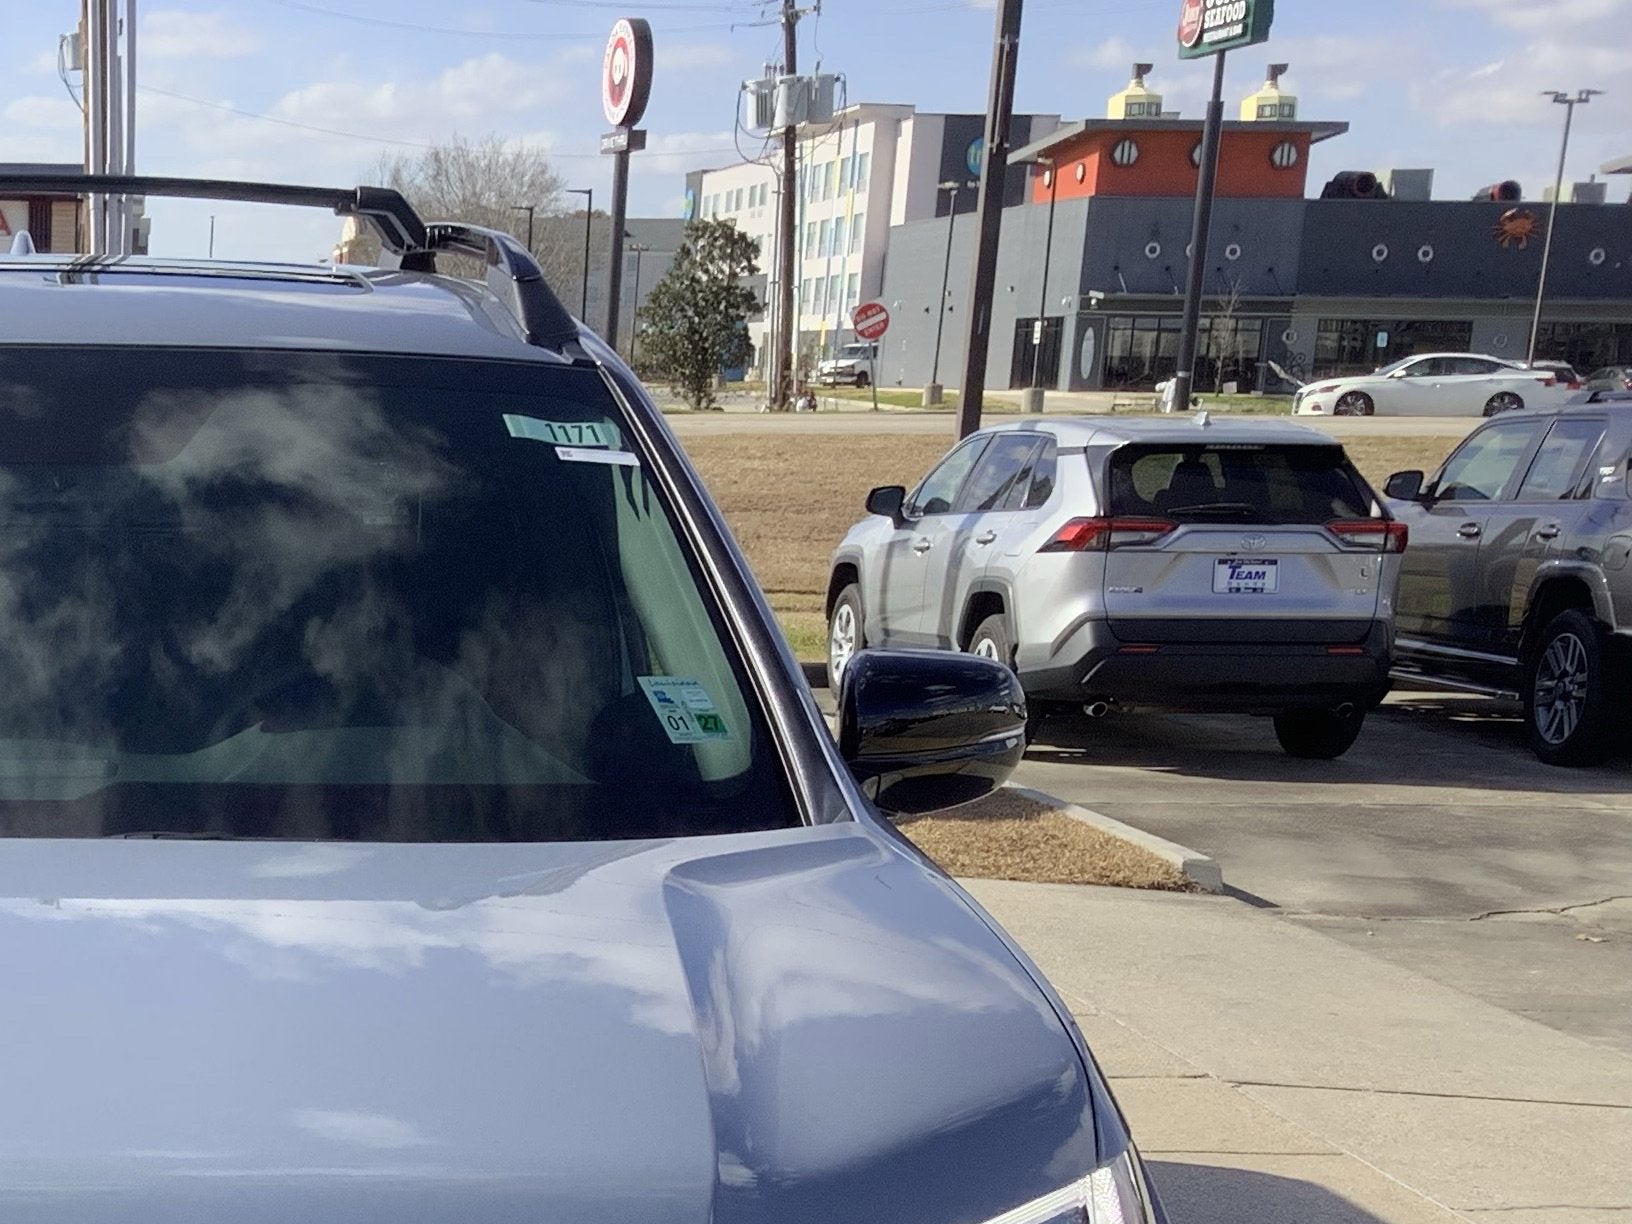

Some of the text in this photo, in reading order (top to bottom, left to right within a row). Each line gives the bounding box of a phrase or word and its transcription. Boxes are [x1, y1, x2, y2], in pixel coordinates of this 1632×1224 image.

[1204, 1, 1246, 28] SEAFOOD
[544, 423, 601, 444] 1171
[1228, 565, 1267, 580] TEAM
[667, 715, 721, 732] 01 27
